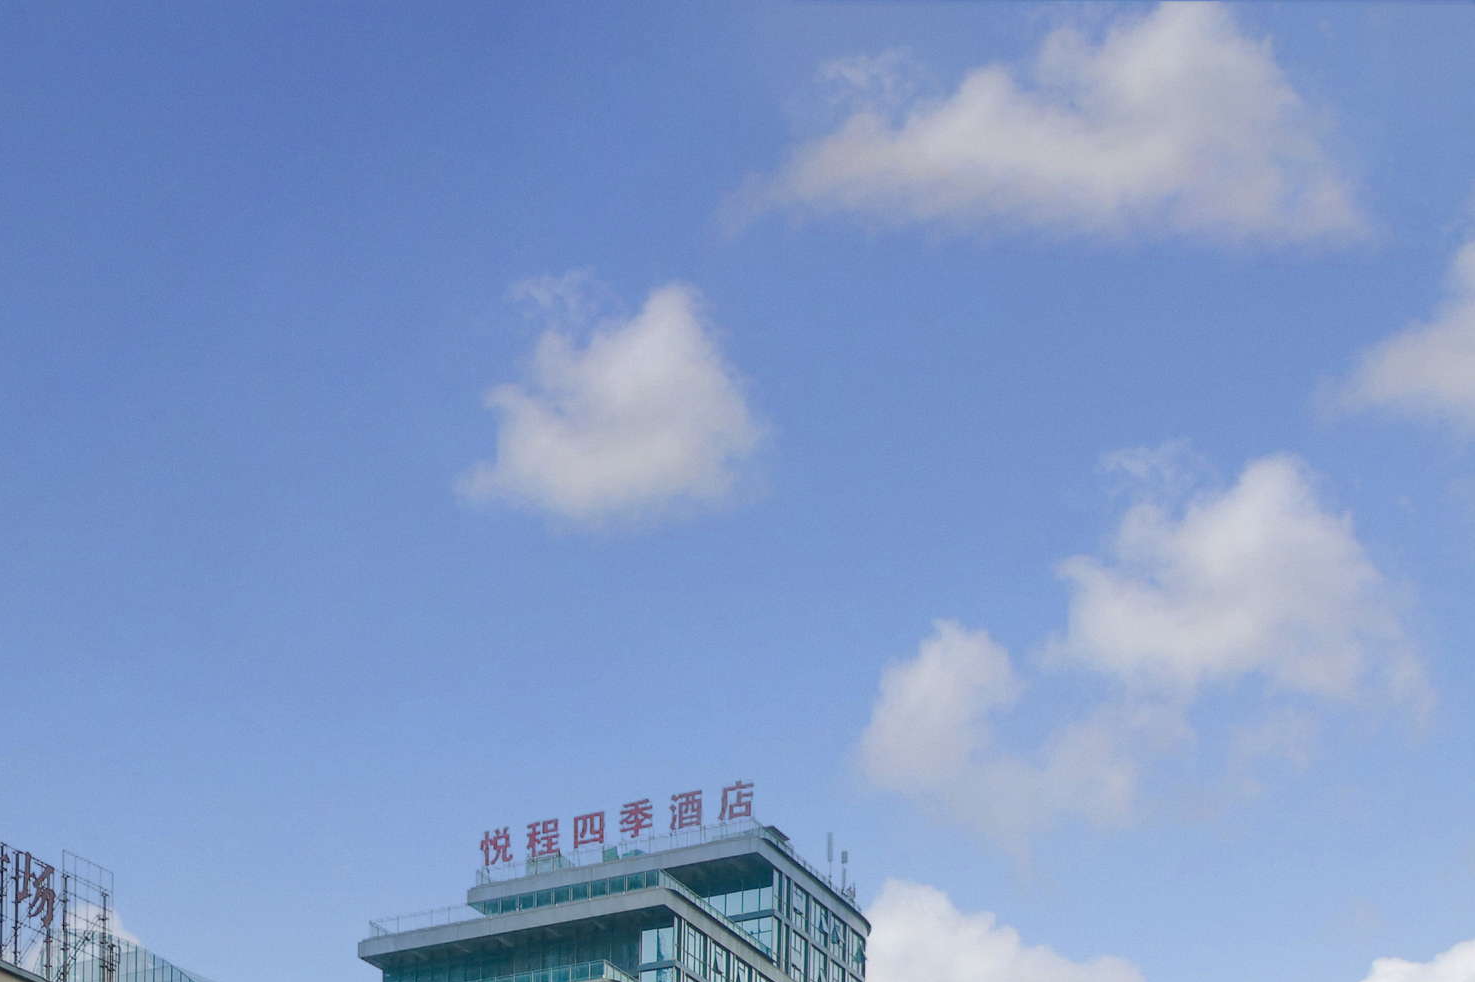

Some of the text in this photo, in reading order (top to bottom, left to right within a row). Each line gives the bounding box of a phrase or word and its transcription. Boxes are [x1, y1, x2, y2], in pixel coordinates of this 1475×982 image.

[480, 780, 755, 866] 悦程四季酒店
